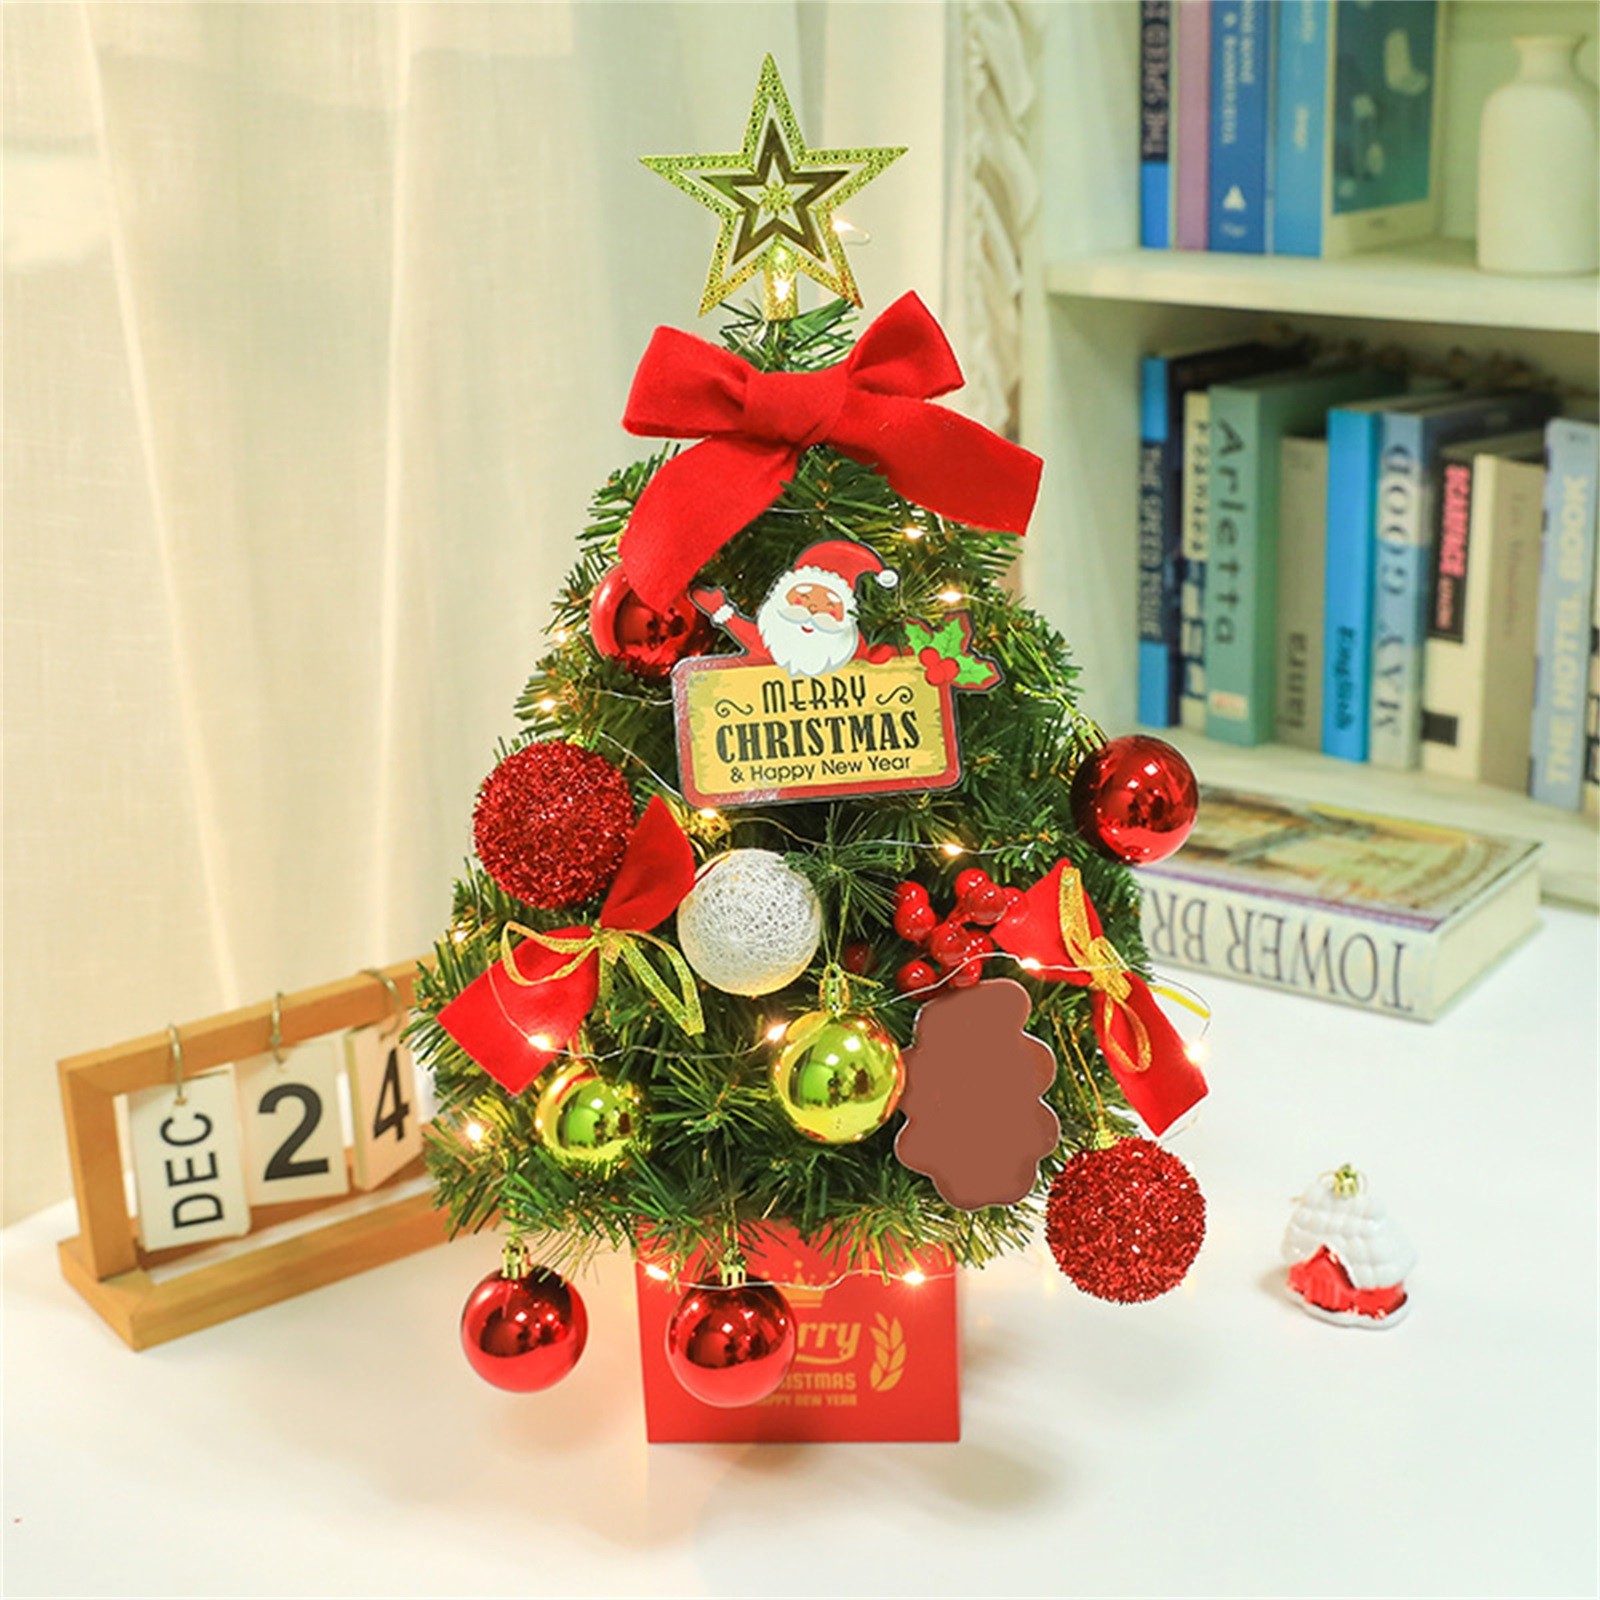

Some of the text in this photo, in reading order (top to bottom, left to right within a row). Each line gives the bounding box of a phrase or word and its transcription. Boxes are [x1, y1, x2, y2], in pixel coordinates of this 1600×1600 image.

[1213, 419, 1246, 644] Arletta
[1559, 474, 1588, 582] BOOK
[1375, 445, 1412, 737] MAY GOOD
[762, 675, 866, 714] MERRY
[1552, 590, 1583, 709] HOTEL
[715, 710, 920, 763] CHRISTMAS
[731, 756, 911, 783] & Happy New Year
[1546, 715, 1577, 786] THE
[1140, 888, 1415, 1012] TOWER BR
[160, 1047, 410, 1229] DEC 2 4
[796, 1322, 861, 1365] rry
